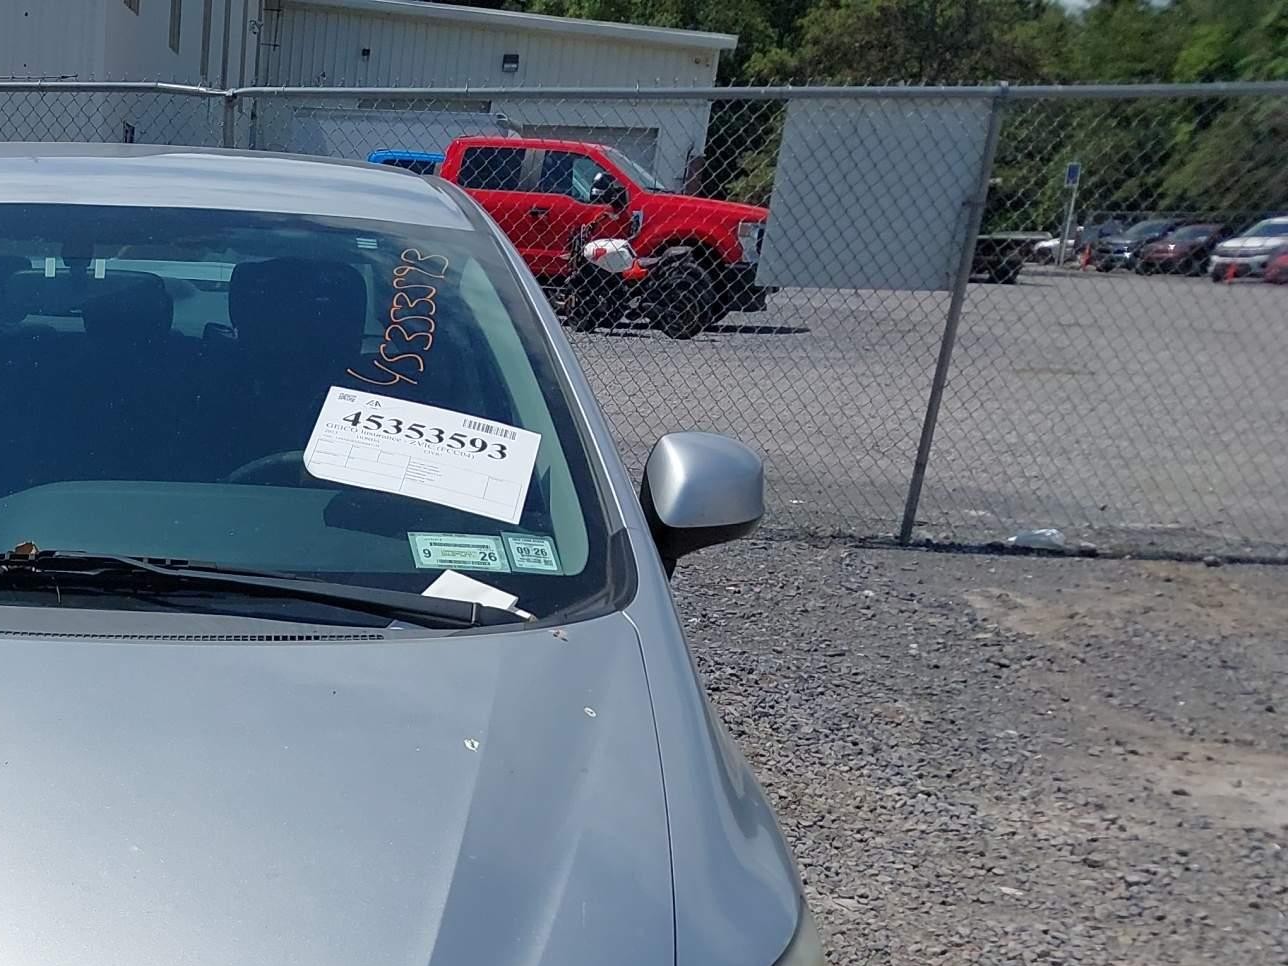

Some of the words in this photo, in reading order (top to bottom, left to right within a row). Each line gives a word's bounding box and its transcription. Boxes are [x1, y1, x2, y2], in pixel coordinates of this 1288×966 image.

[342, 410, 508, 461] 45353593
[422, 548, 432, 558] 9
[478, 551, 498, 562] 26
[533, 547, 548, 557] 26
